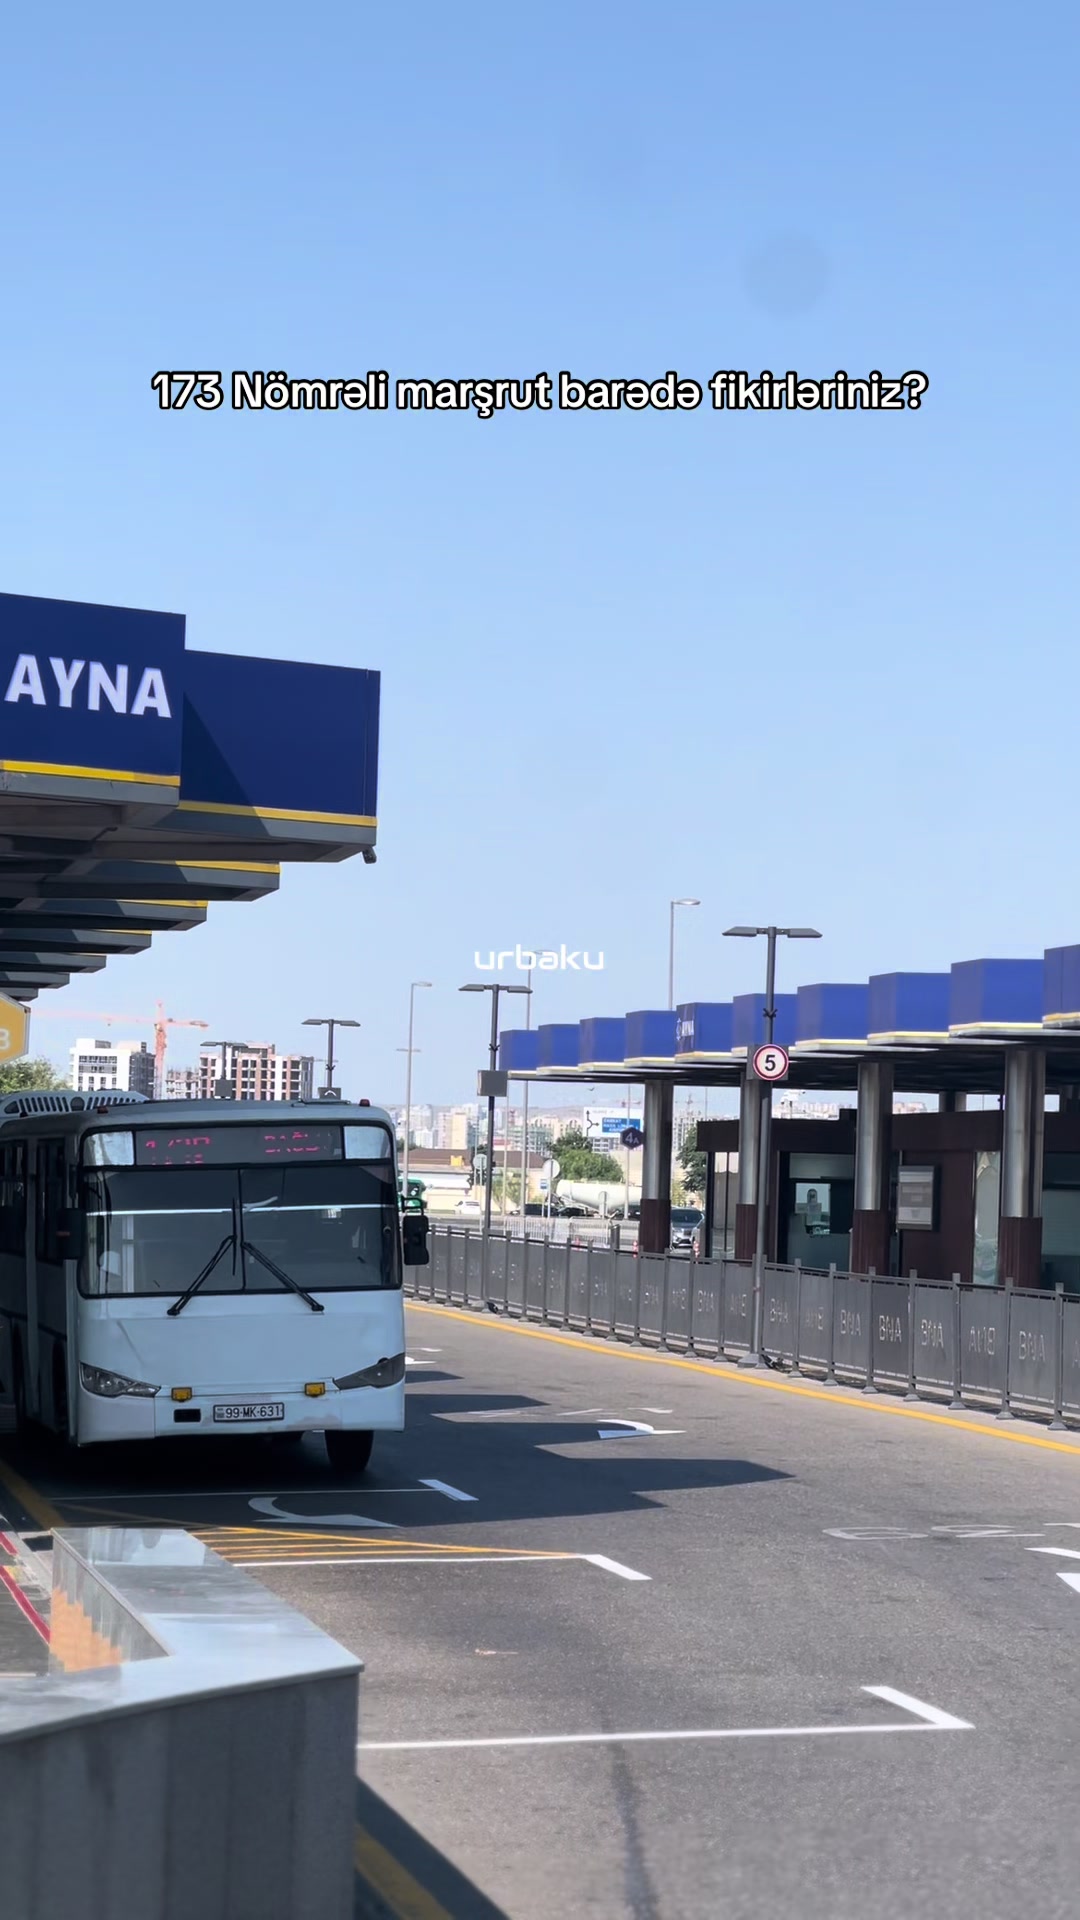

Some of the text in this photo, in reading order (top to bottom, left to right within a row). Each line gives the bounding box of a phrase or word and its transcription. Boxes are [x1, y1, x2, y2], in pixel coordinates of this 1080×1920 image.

[4, 653, 172, 718] AYNA
[764, 1054, 776, 1072] 5
[879, 1315, 902, 1342] BNA
[225, 1405, 280, 1419] 99-MK-631
